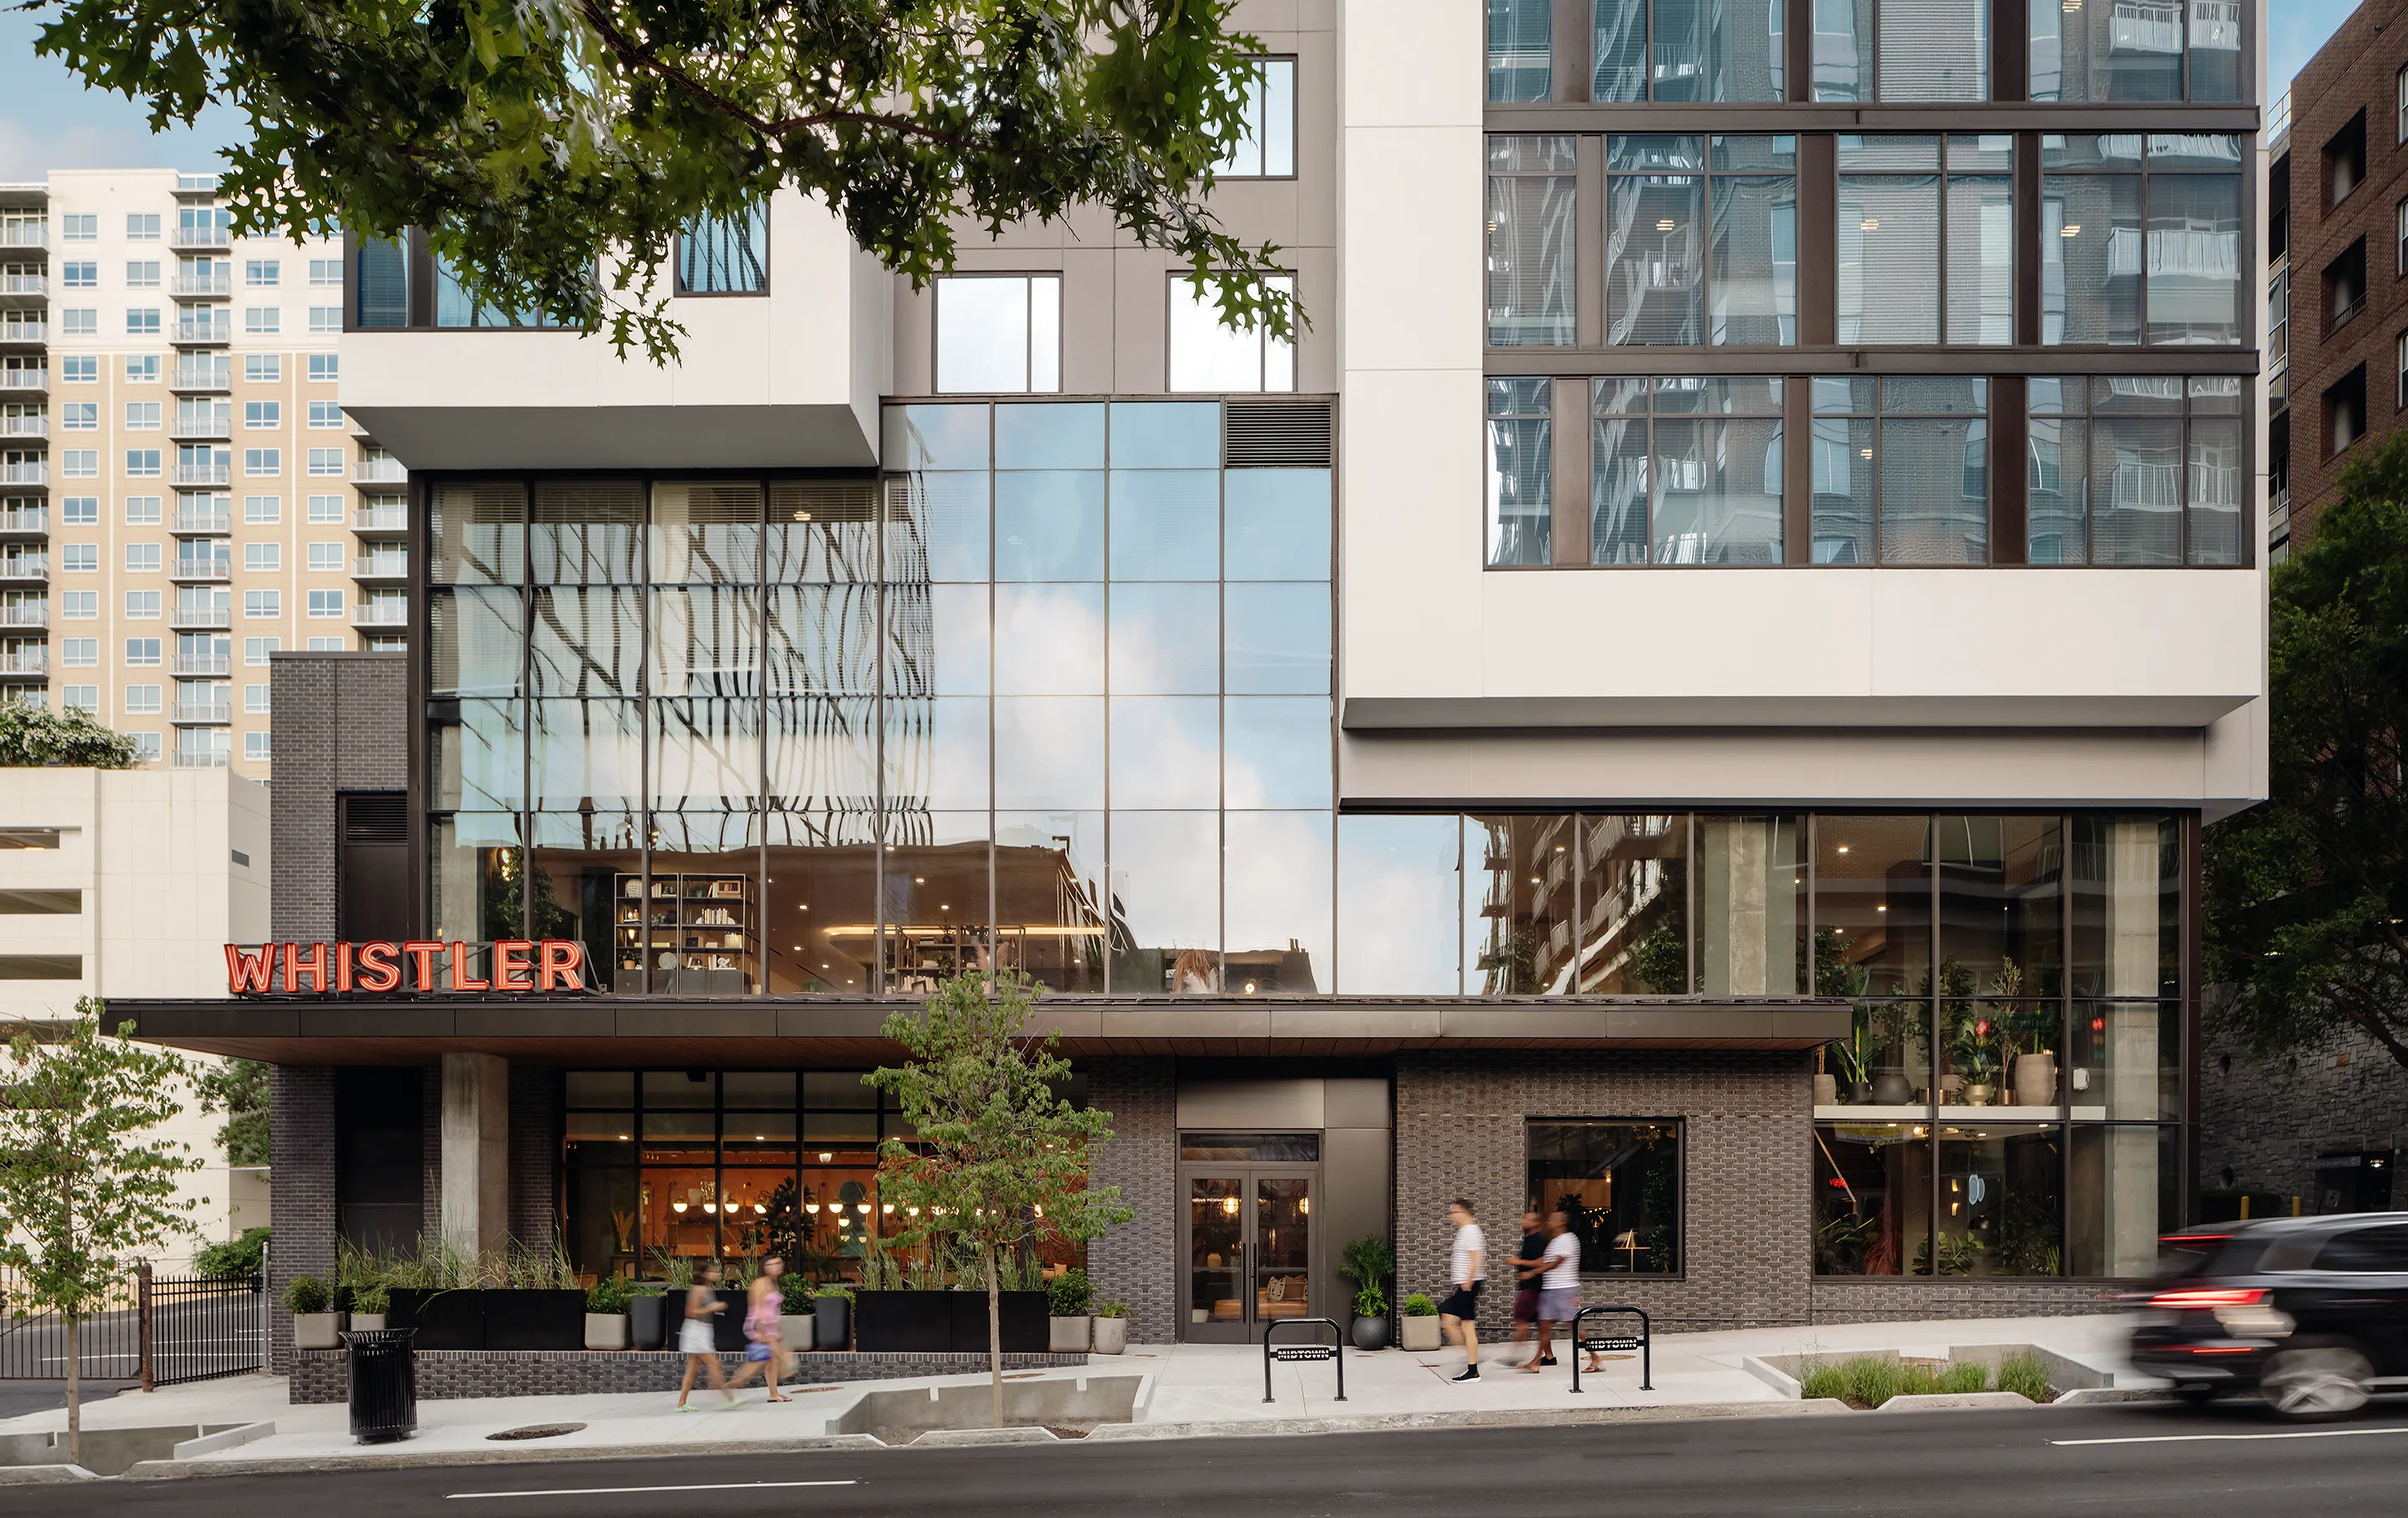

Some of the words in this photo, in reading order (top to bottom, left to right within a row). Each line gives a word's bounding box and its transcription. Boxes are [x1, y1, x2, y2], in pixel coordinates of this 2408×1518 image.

[223, 940, 584, 992] WHISTLER
[1586, 1339, 1636, 1348] MIDTOWN
[1278, 1350, 1329, 1359] MIDTOWN
